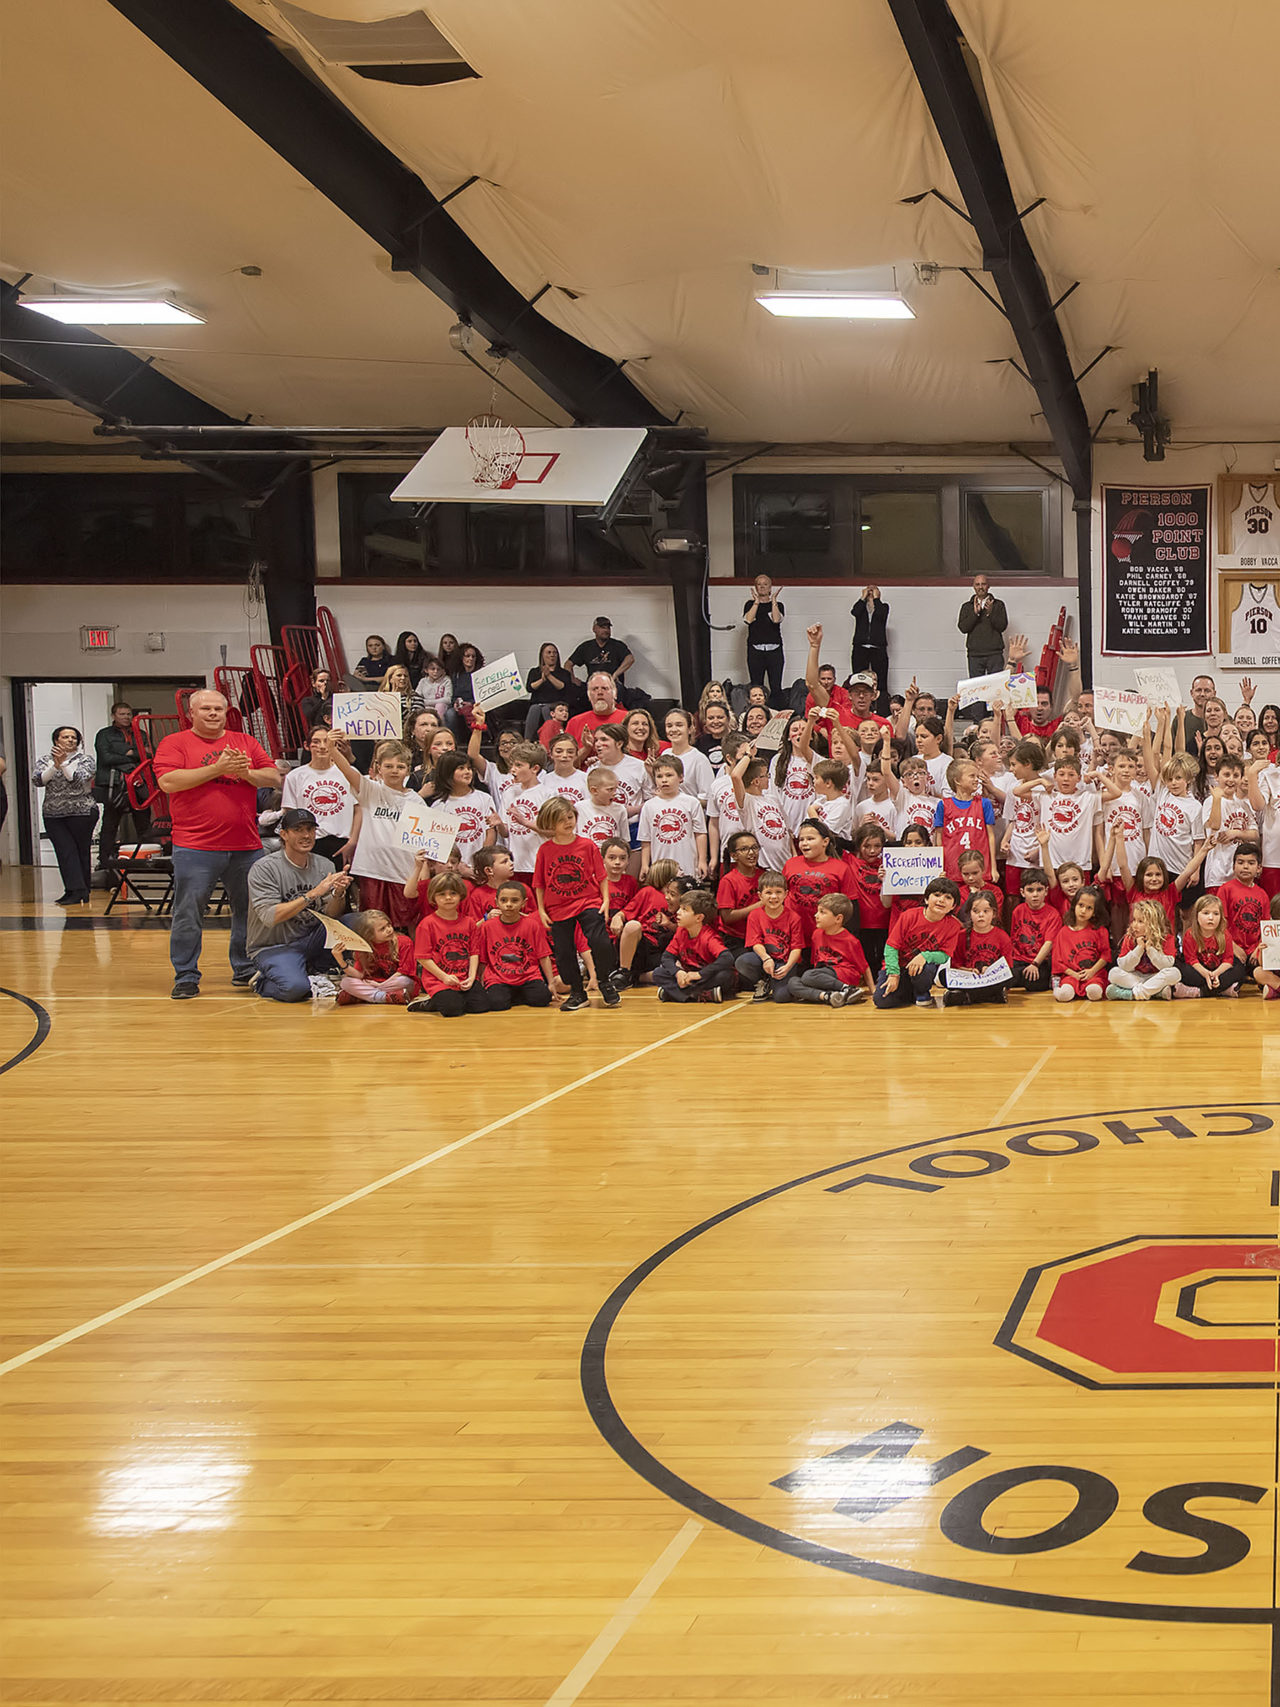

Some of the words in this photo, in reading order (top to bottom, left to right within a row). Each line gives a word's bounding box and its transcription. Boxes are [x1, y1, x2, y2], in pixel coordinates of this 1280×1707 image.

[1121, 493, 1192, 505] PIERSON
[1158, 512, 1199, 526] 1000
[1244, 505, 1273, 522] PIERSON
[1247, 518, 1270, 534] 30
[1152, 529, 1203, 544] POINT
[1155, 546, 1200, 560] CLUB
[1240, 557, 1257, 566] BOBBY
[1261, 557, 1278, 566] VACCA
[1244, 606, 1273, 622] PIERSON
[1250, 618, 1267, 634] 10
[89, 630, 109, 646] EXIT
[1234, 656, 1256, 665] DARNELL
[1261, 656, 1280, 665] COFFEY
[1095, 690, 1117, 701] SAG
[1118, 692, 1148, 705] HARBO
[1102, 706, 1144, 727] VFW
[345, 717, 397, 737] MEDIA
[302, 785, 315, 798] SAG
[316, 780, 347, 796] HARBOR
[782, 788, 800, 800] YOUTH
[801, 788, 815, 800] HOOP
[307, 804, 328, 817] YOUTH
[330, 802, 345, 816] HOOP
[455, 806, 483, 821] HARBOR
[1108, 811, 1118, 824] SAG
[1119, 805, 1142, 824] HARBOR
[652, 814, 661, 828] SAG
[661, 809, 688, 824] HARBOR
[946, 816, 983, 834] HYAL
[582, 820, 593, 834] SAG
[960, 832, 971, 849] 4
[884, 853, 942, 869] RECREATIONAL
